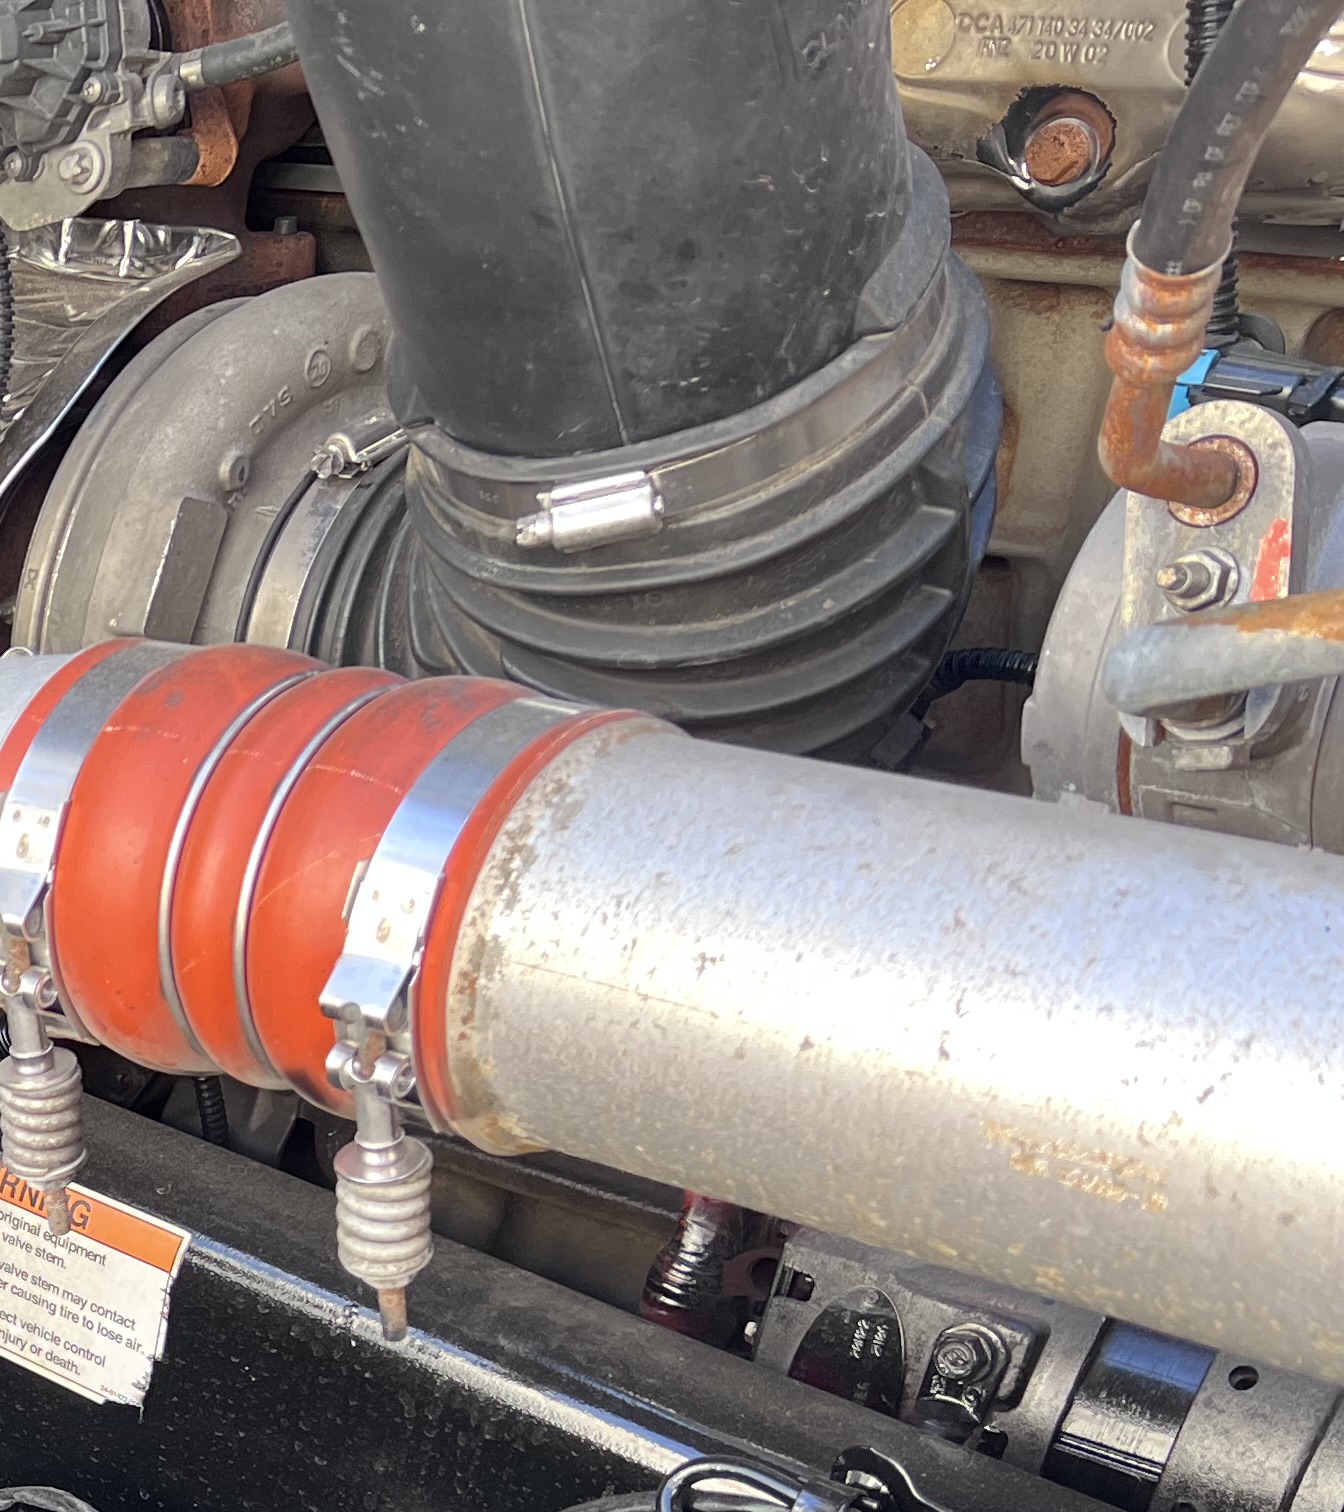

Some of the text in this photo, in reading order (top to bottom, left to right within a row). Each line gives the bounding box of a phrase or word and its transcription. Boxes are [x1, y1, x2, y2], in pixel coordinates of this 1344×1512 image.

[1, 1229, 33, 1254] valve
[34, 1246, 67, 1269] stem.
[43, 1229, 108, 1267] equipment
[10, 1283, 57, 1316] causing
[59, 1303, 80, 1324] tire
[81, 1314, 95, 1332] to
[96, 1322, 124, 1345] lose
[124, 1335, 146, 1356] air.
[30, 1273, 61, 1296] stem
[61, 1288, 90, 1311] may
[89, 1301, 137, 1332] contact
[19, 1317, 62, 1347] vehicle
[62, 1338, 108, 1368] control
[29, 1342, 43, 1358] or
[44, 1348, 82, 1377] death.
